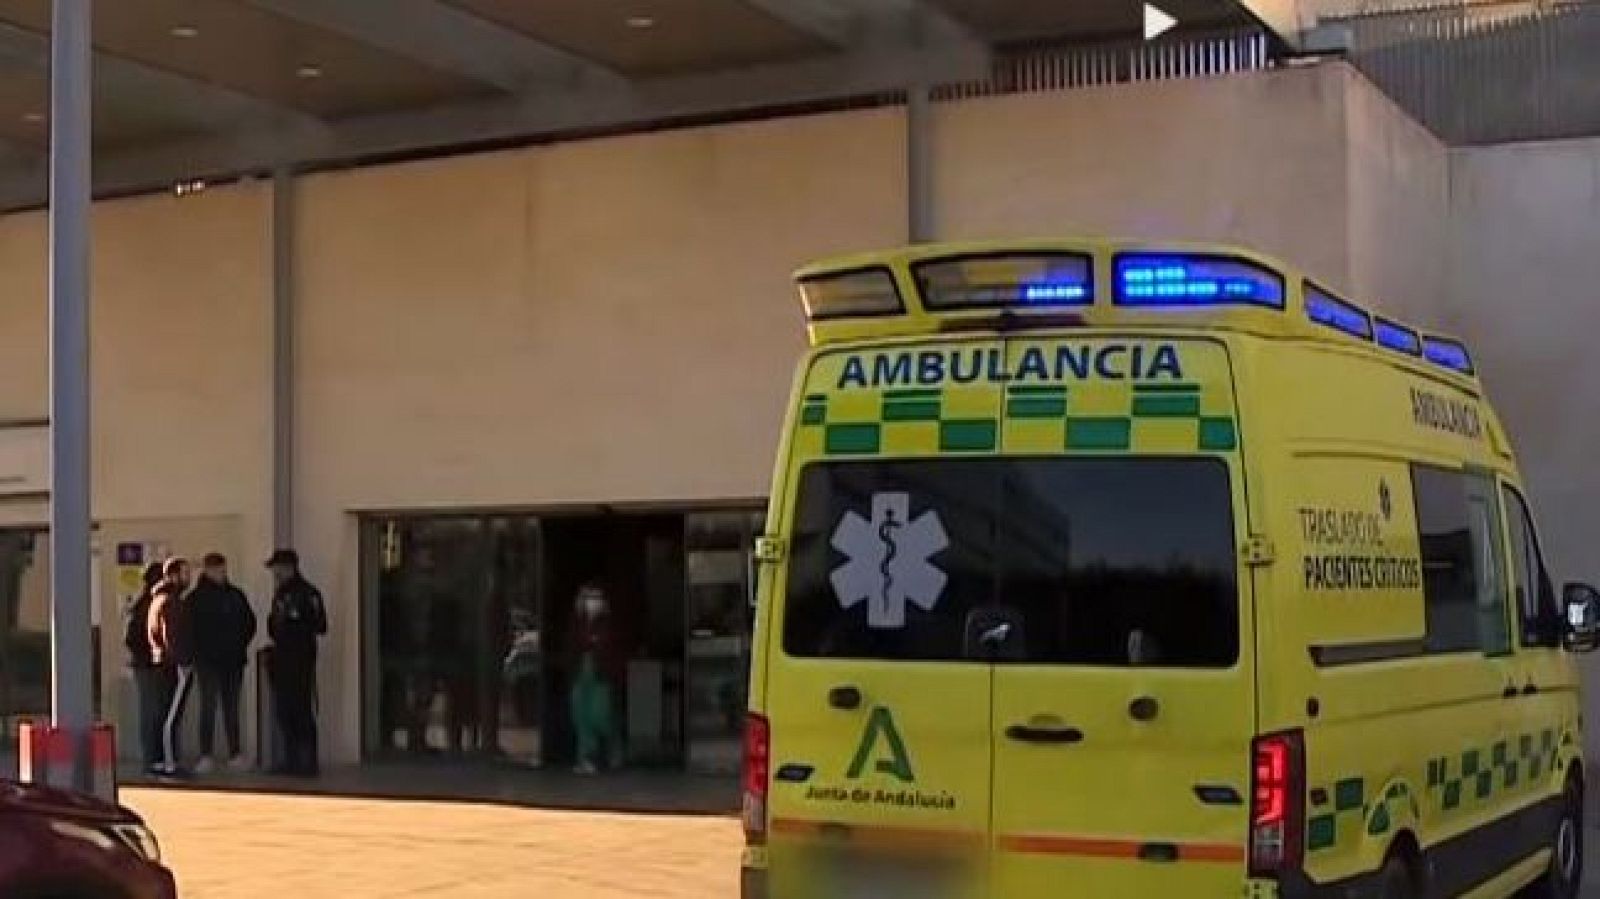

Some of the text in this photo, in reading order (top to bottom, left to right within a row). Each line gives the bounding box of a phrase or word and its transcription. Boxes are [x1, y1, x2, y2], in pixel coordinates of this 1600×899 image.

[838, 344, 1182, 389] AMBULANCIA
[1304, 555, 1372, 589] PACIENTES
[805, 785, 848, 800] Junta
[851, 787, 870, 803] de
